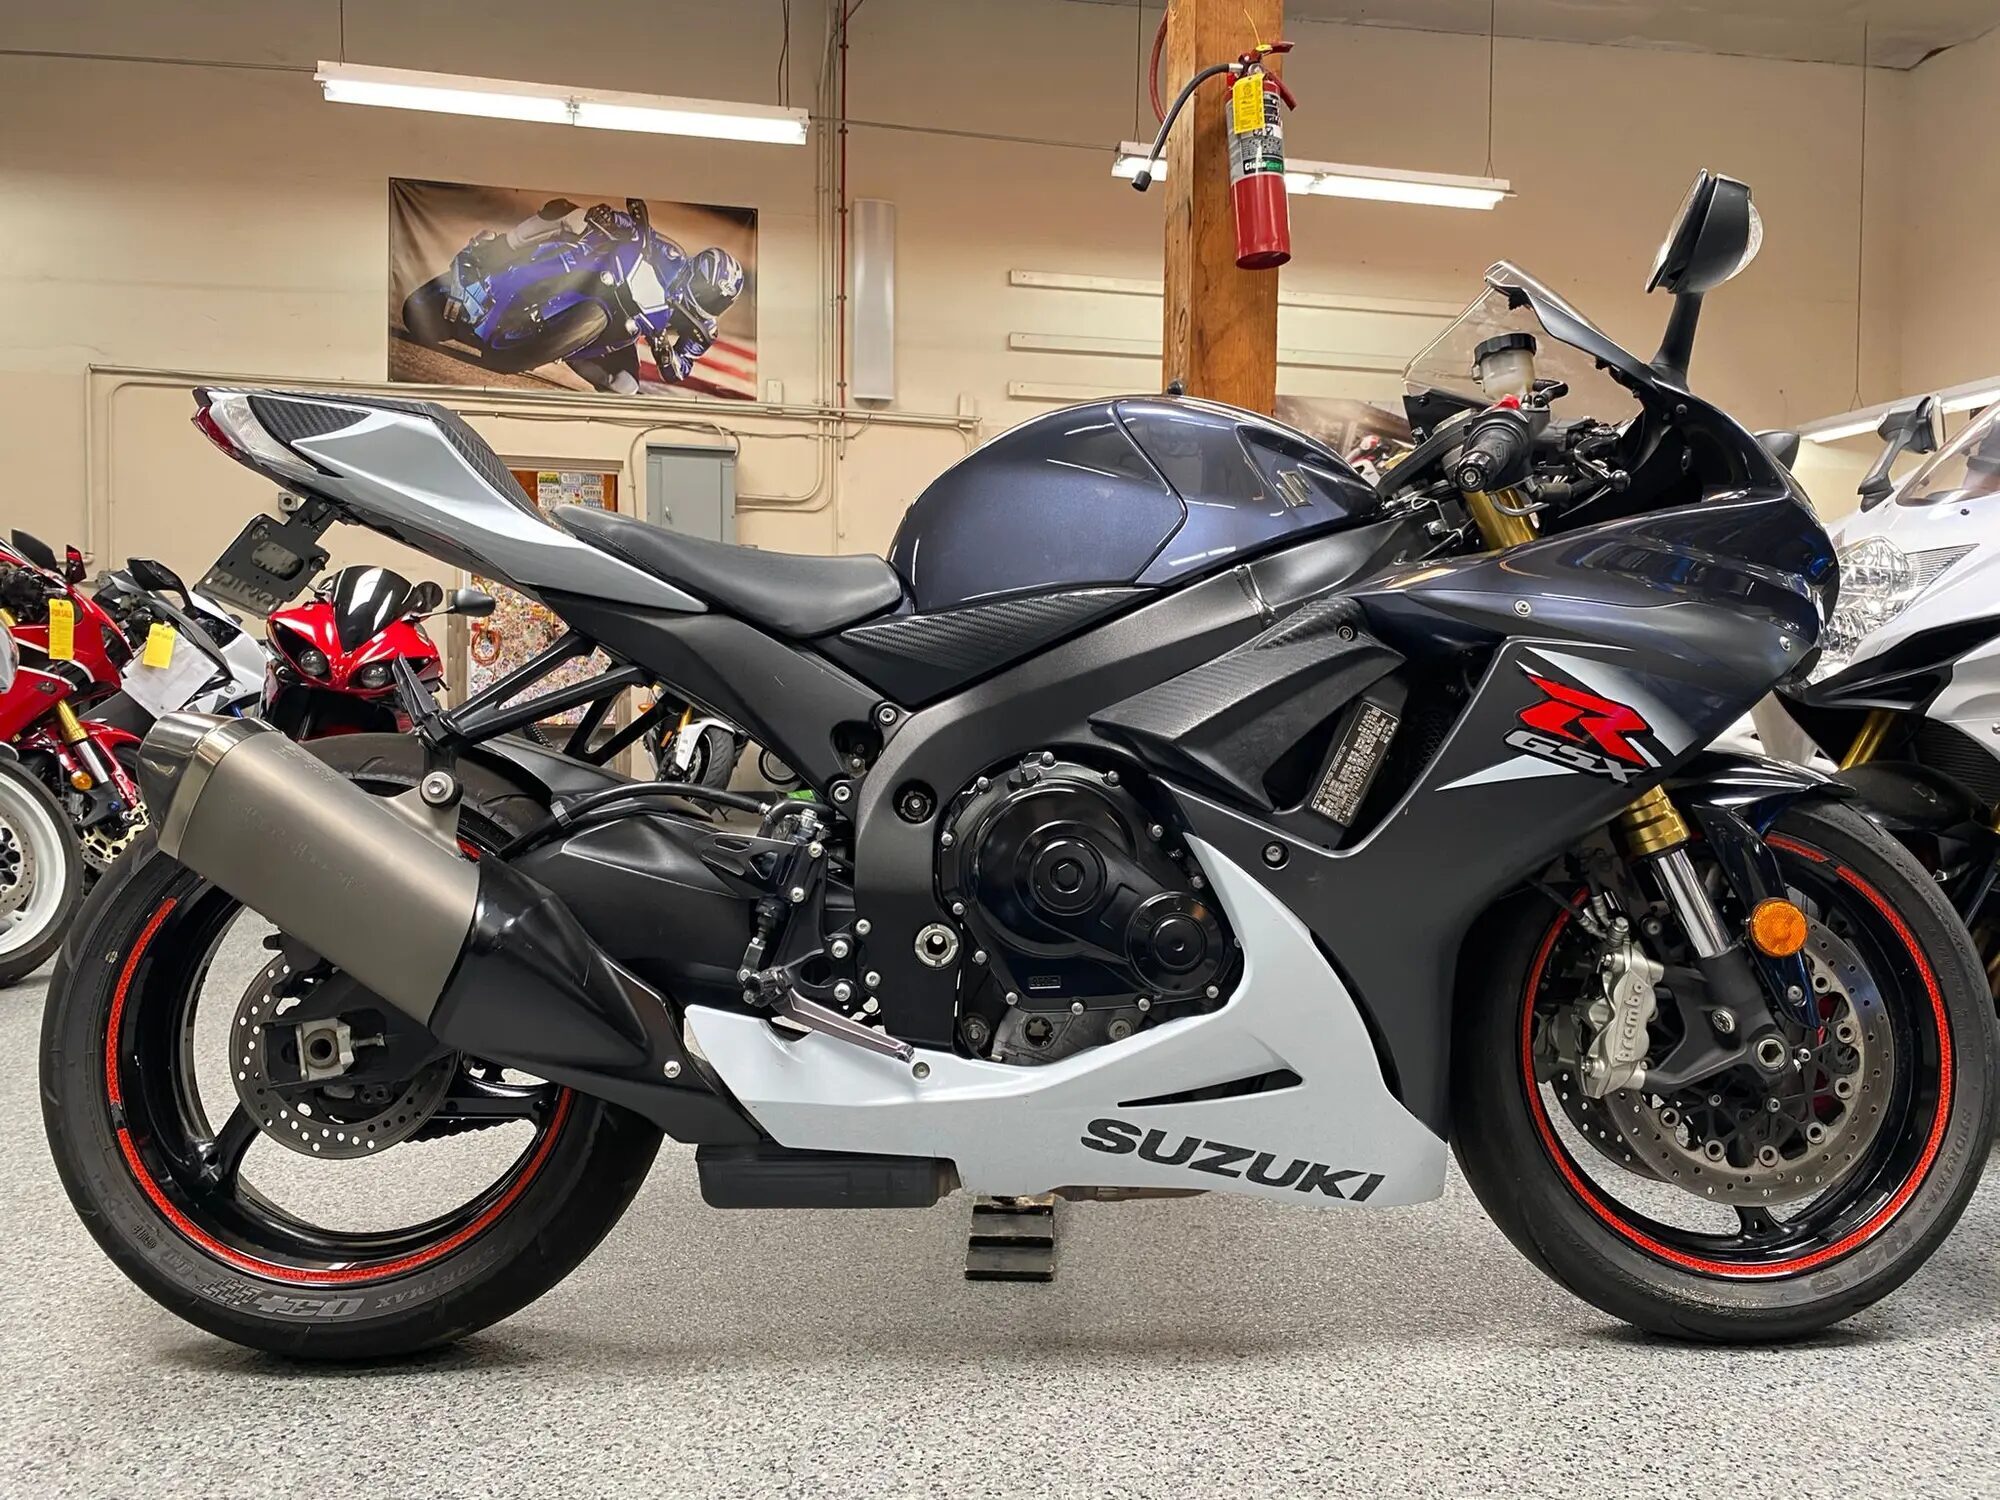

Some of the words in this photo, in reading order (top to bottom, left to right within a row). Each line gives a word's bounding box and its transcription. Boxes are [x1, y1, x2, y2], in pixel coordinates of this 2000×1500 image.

[1504, 729, 1646, 784] GSX
[1615, 982, 1642, 1062] brembo
[1080, 1117, 1386, 1202] SUZUKI
